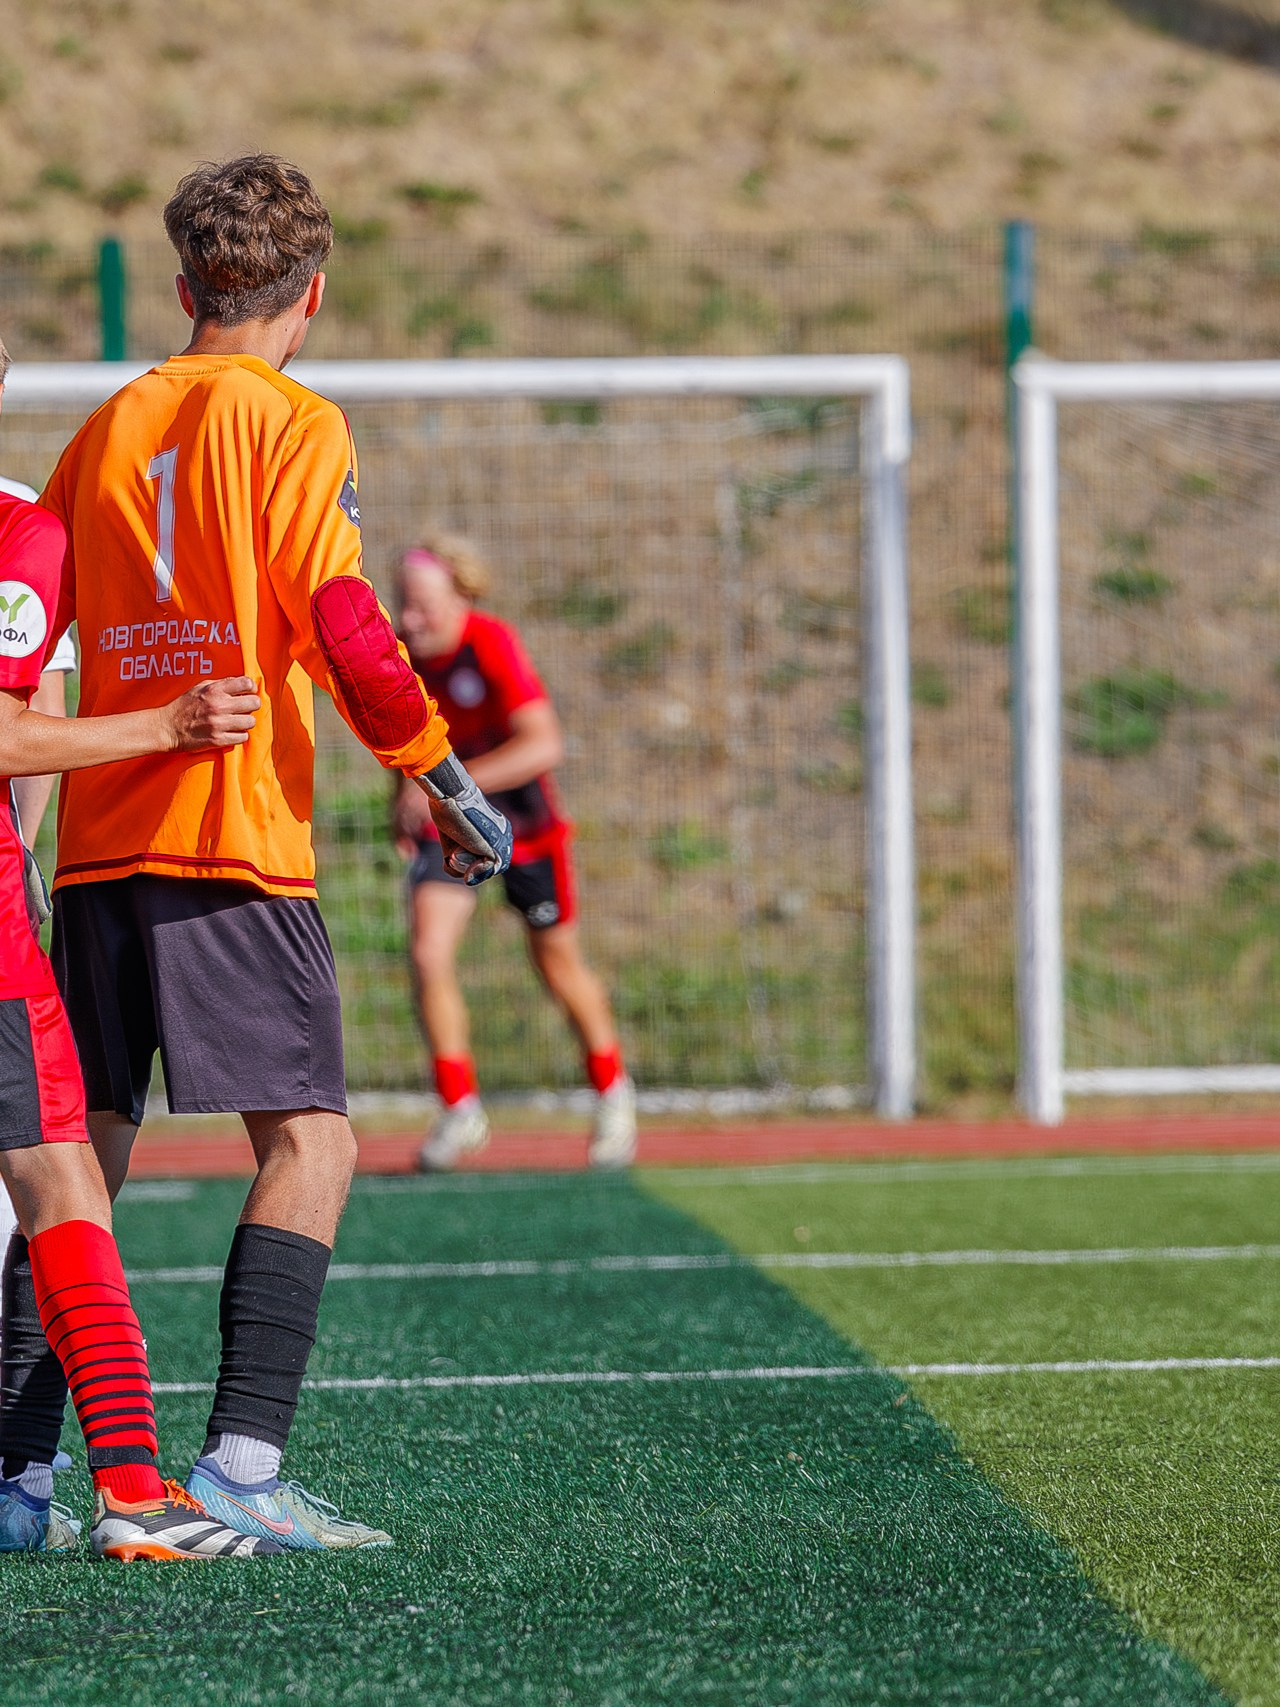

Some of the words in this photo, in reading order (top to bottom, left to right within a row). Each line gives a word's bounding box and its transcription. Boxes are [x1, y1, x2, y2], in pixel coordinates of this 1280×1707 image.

[145, 443, 180, 602] 1
[98, 619, 240, 654] НОВГОРОДСКА
[120, 651, 212, 681] ОБЛАСТЬ
